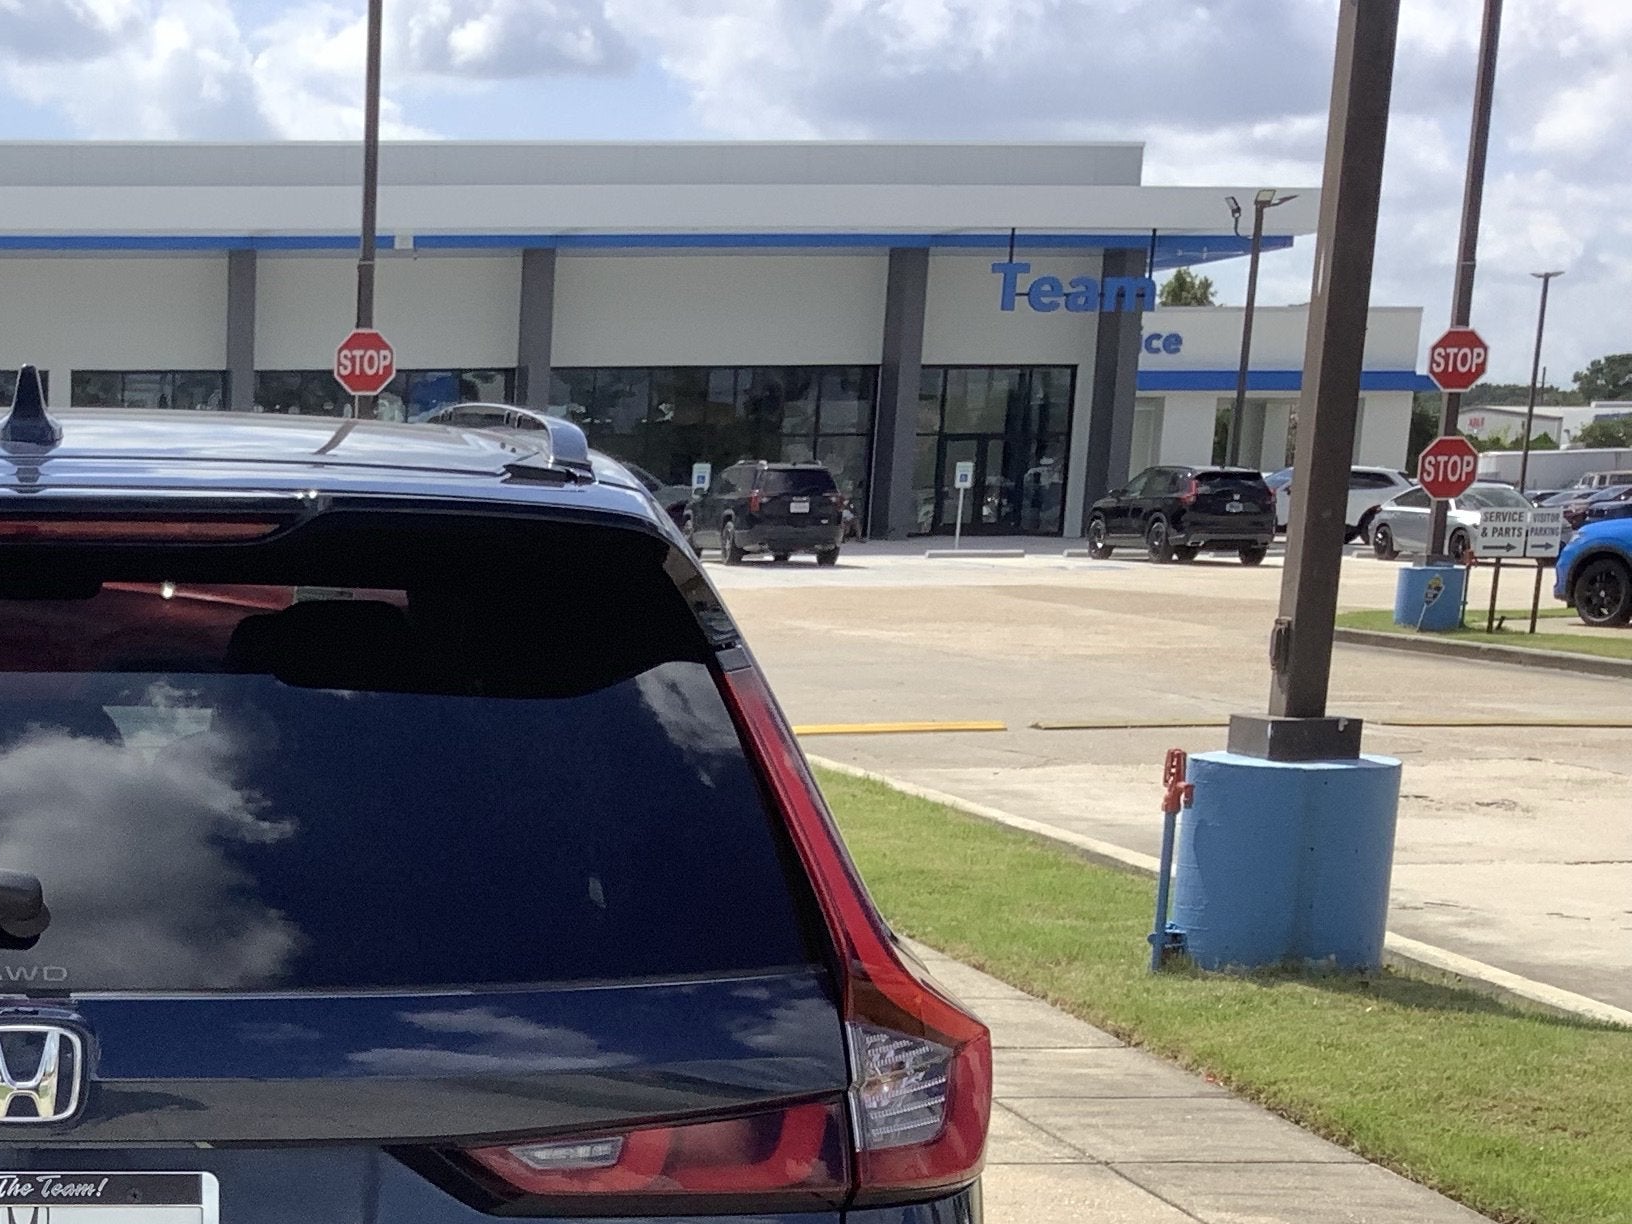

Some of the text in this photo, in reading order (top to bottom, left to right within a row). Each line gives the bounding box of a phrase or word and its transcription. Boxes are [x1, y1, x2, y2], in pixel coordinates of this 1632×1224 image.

[991, 262, 1156, 312] Team
[338, 349, 392, 376] STOP
[1431, 347, 1486, 374] STOP
[1422, 455, 1475, 483] STOP
[1483, 511, 1525, 522] SERVICE
[1533, 512, 1561, 523] VISITOR
[1481, 526, 1523, 538] & PARTS
[1529, 526, 1560, 537] PARKING
[36, 1174, 109, 1198] Team!
